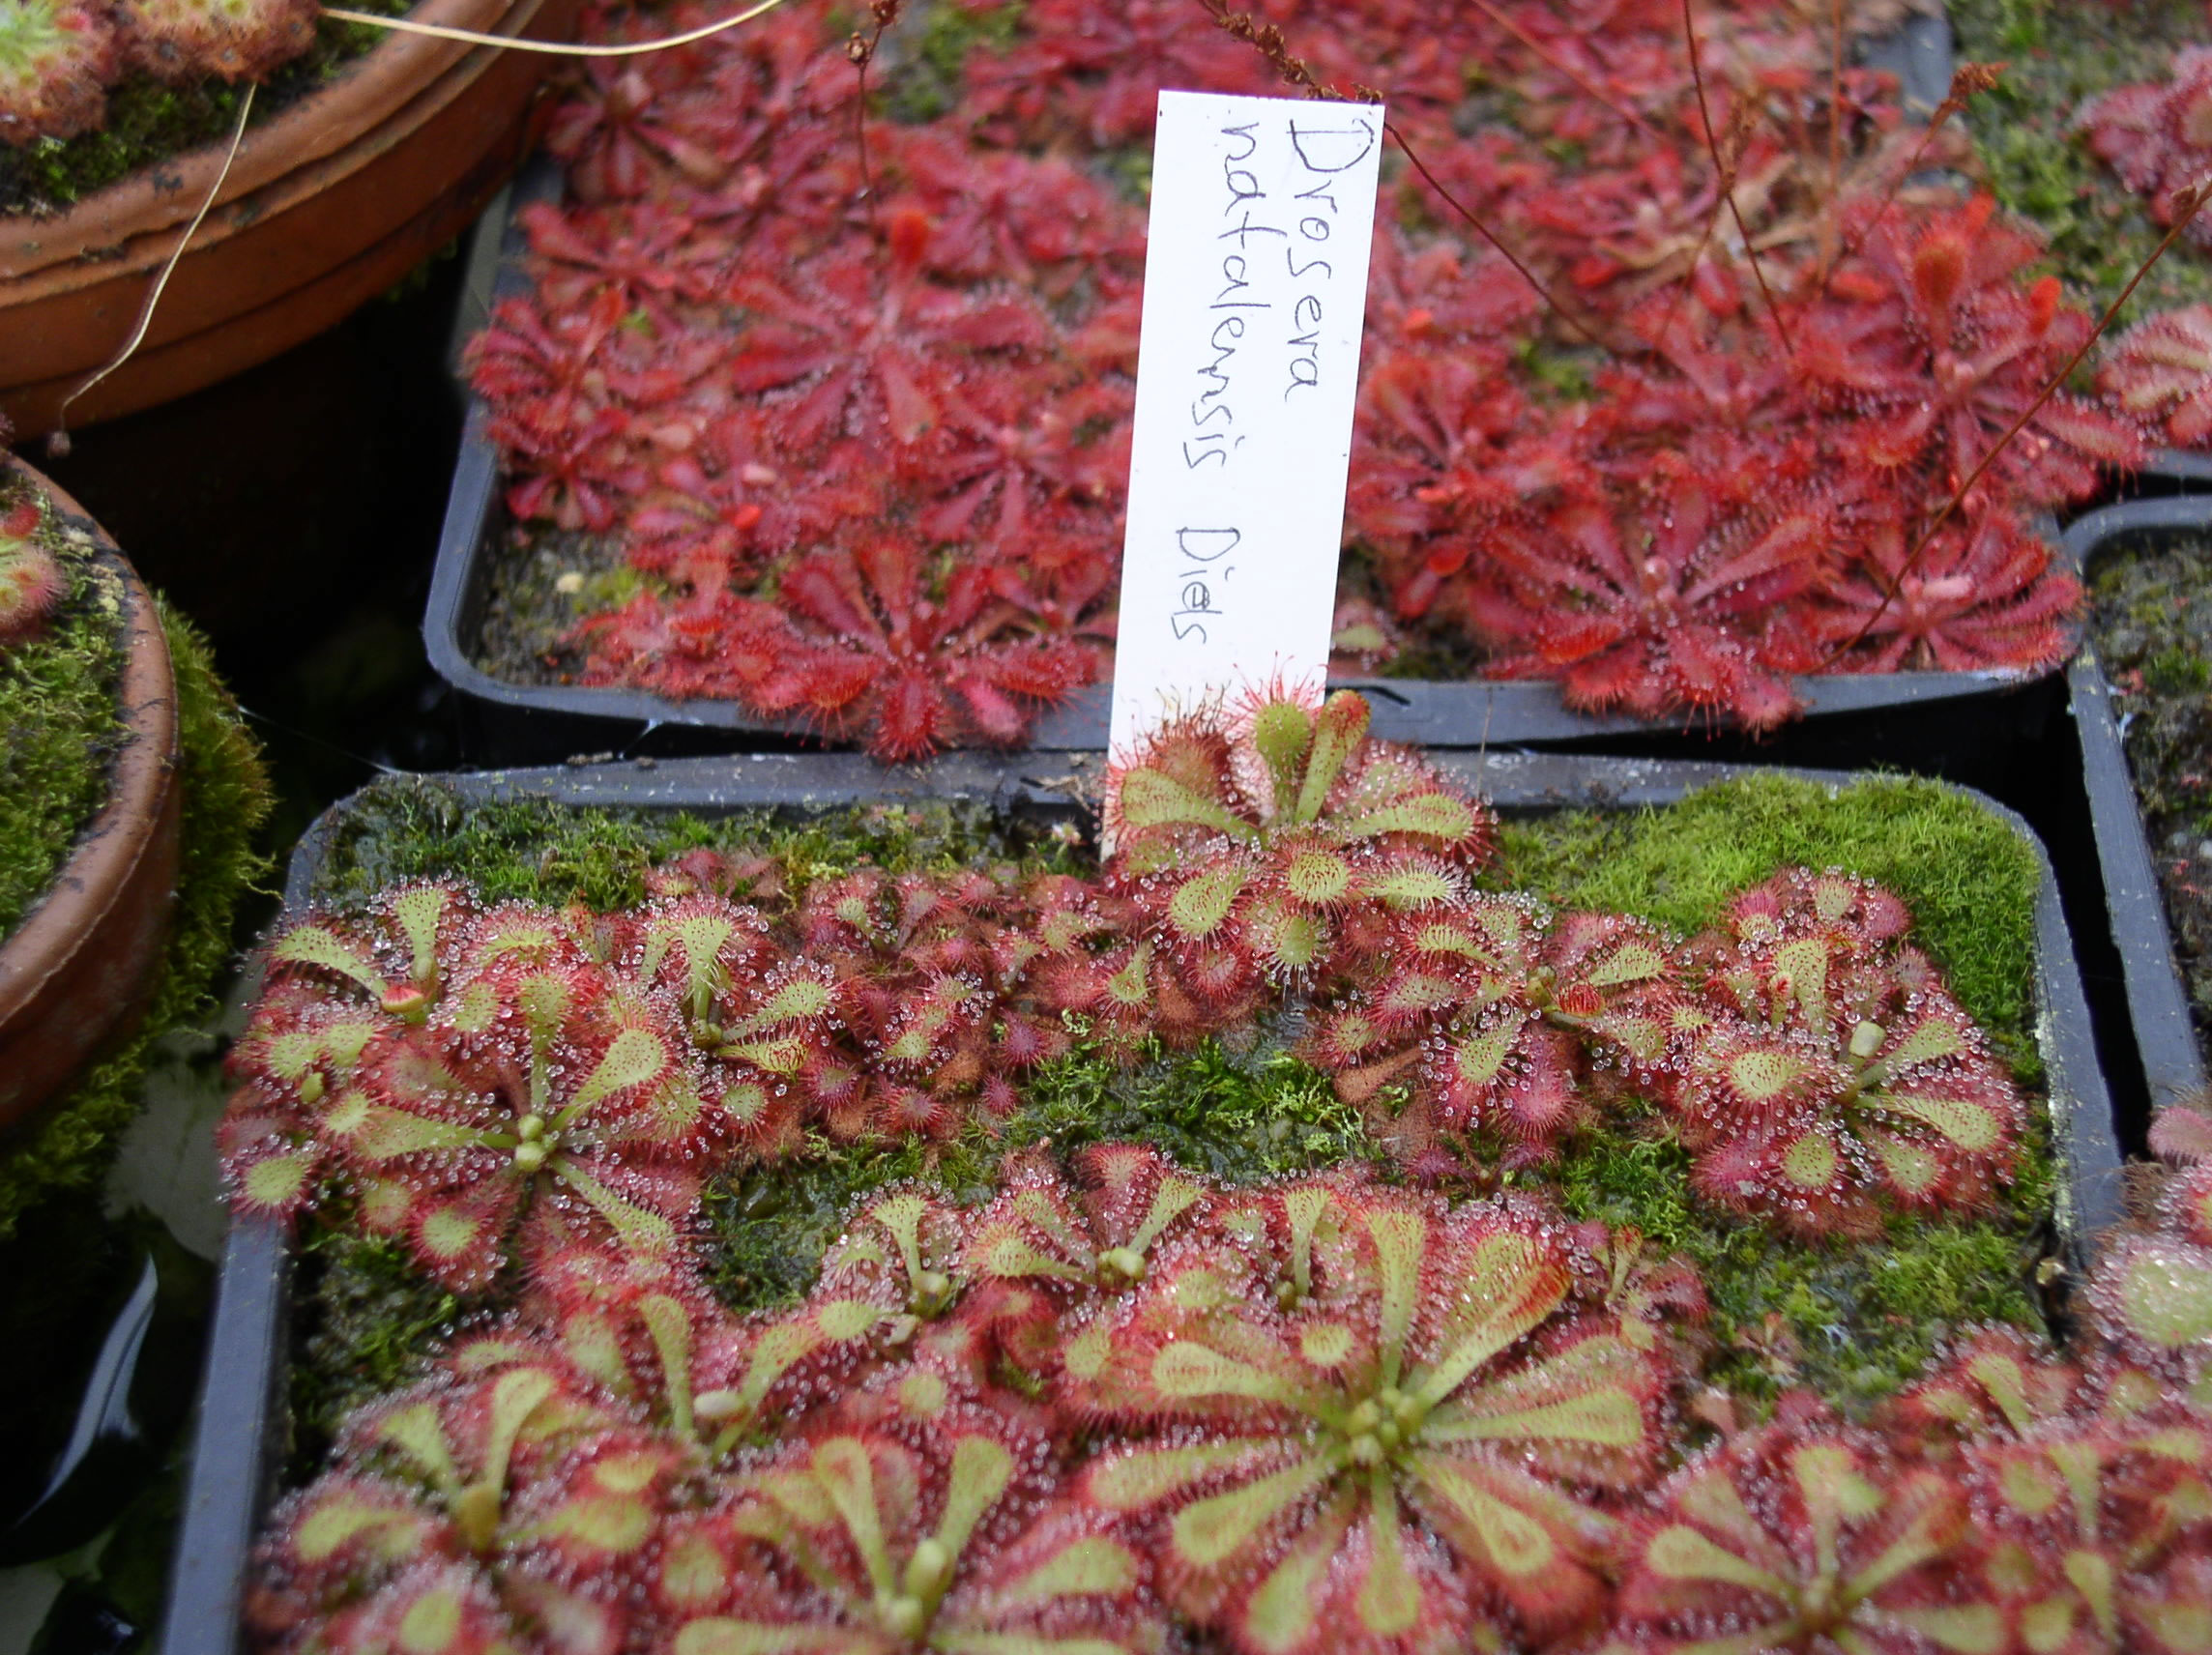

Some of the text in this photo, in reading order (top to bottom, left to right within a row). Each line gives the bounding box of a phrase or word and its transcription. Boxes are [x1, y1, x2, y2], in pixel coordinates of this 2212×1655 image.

[1171, 122, 1288, 644] natalensis Diels
[1285, 118, 1375, 402] Drosera
